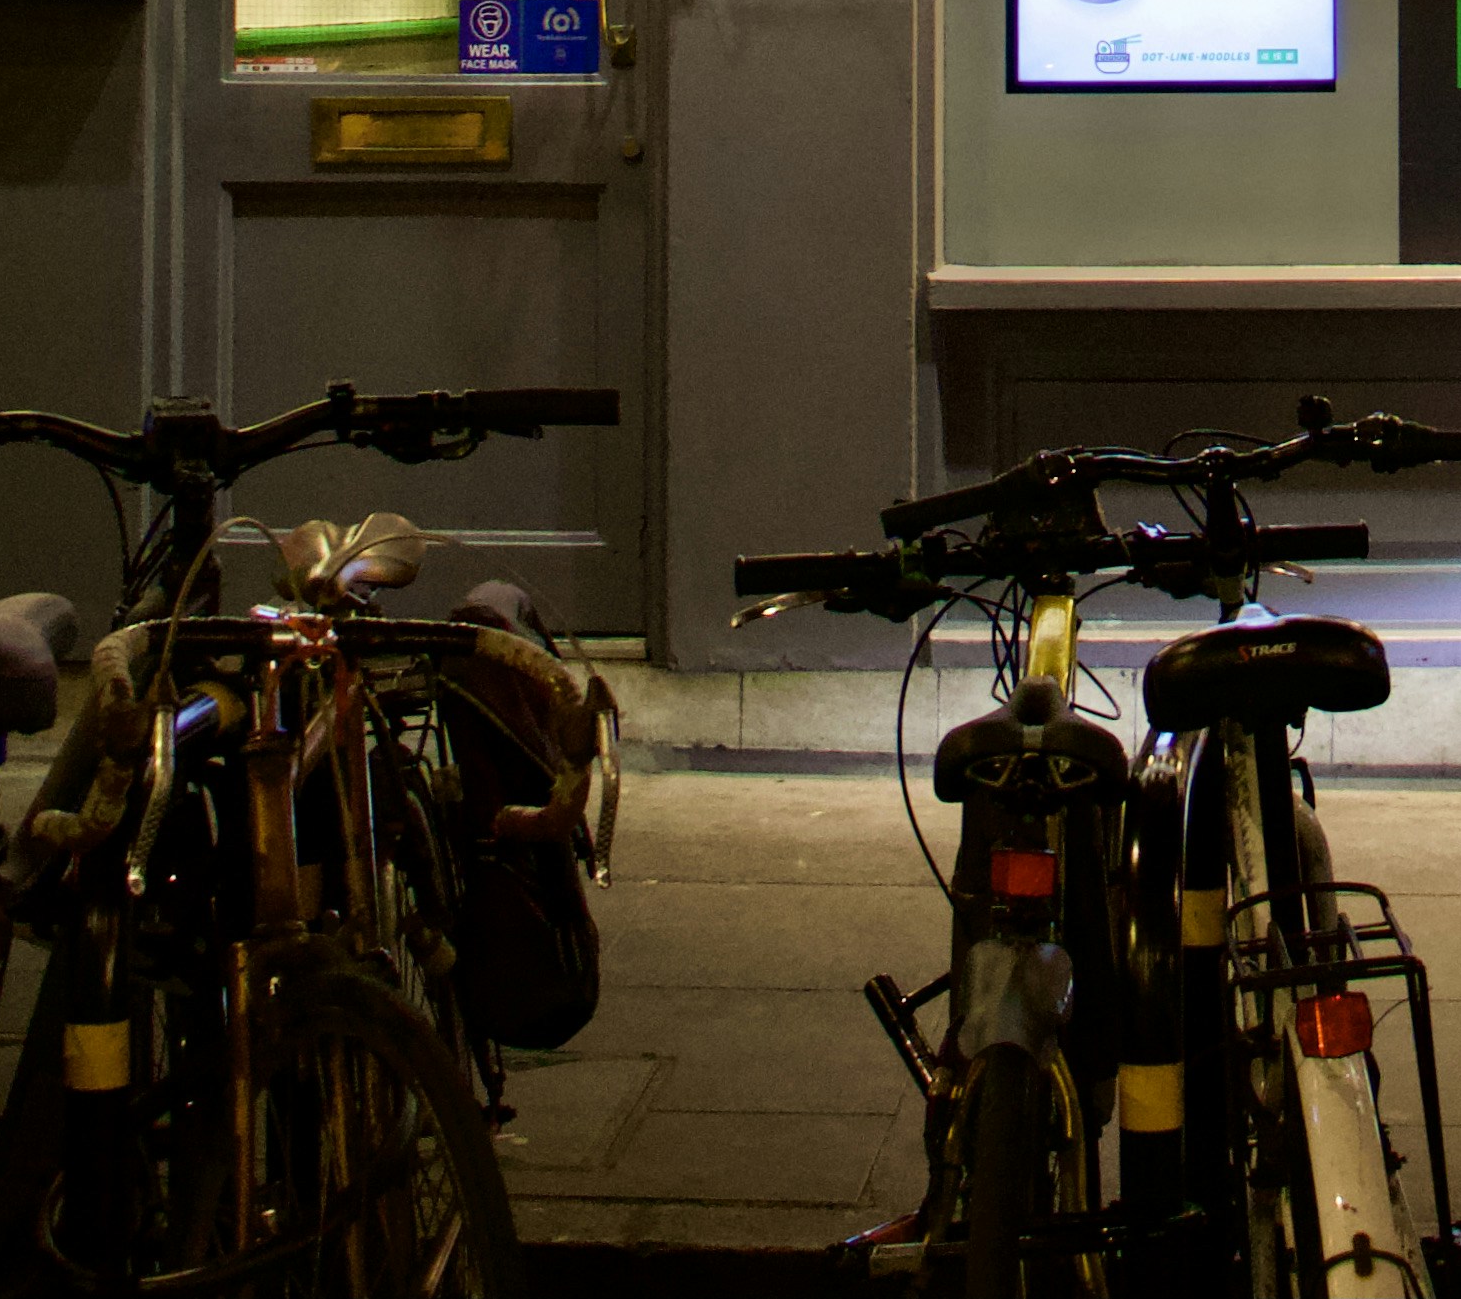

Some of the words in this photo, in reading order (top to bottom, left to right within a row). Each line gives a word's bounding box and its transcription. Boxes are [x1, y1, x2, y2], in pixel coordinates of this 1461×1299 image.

[469, 43, 511, 58] WEAR
[1142, 52, 1164, 62] DOT
[1171, 52, 1195, 62] LINE
[1201, 52, 1251, 62] NOODLES
[461, 58, 487, 71] FACE
[488, 58, 519, 71] MASK
